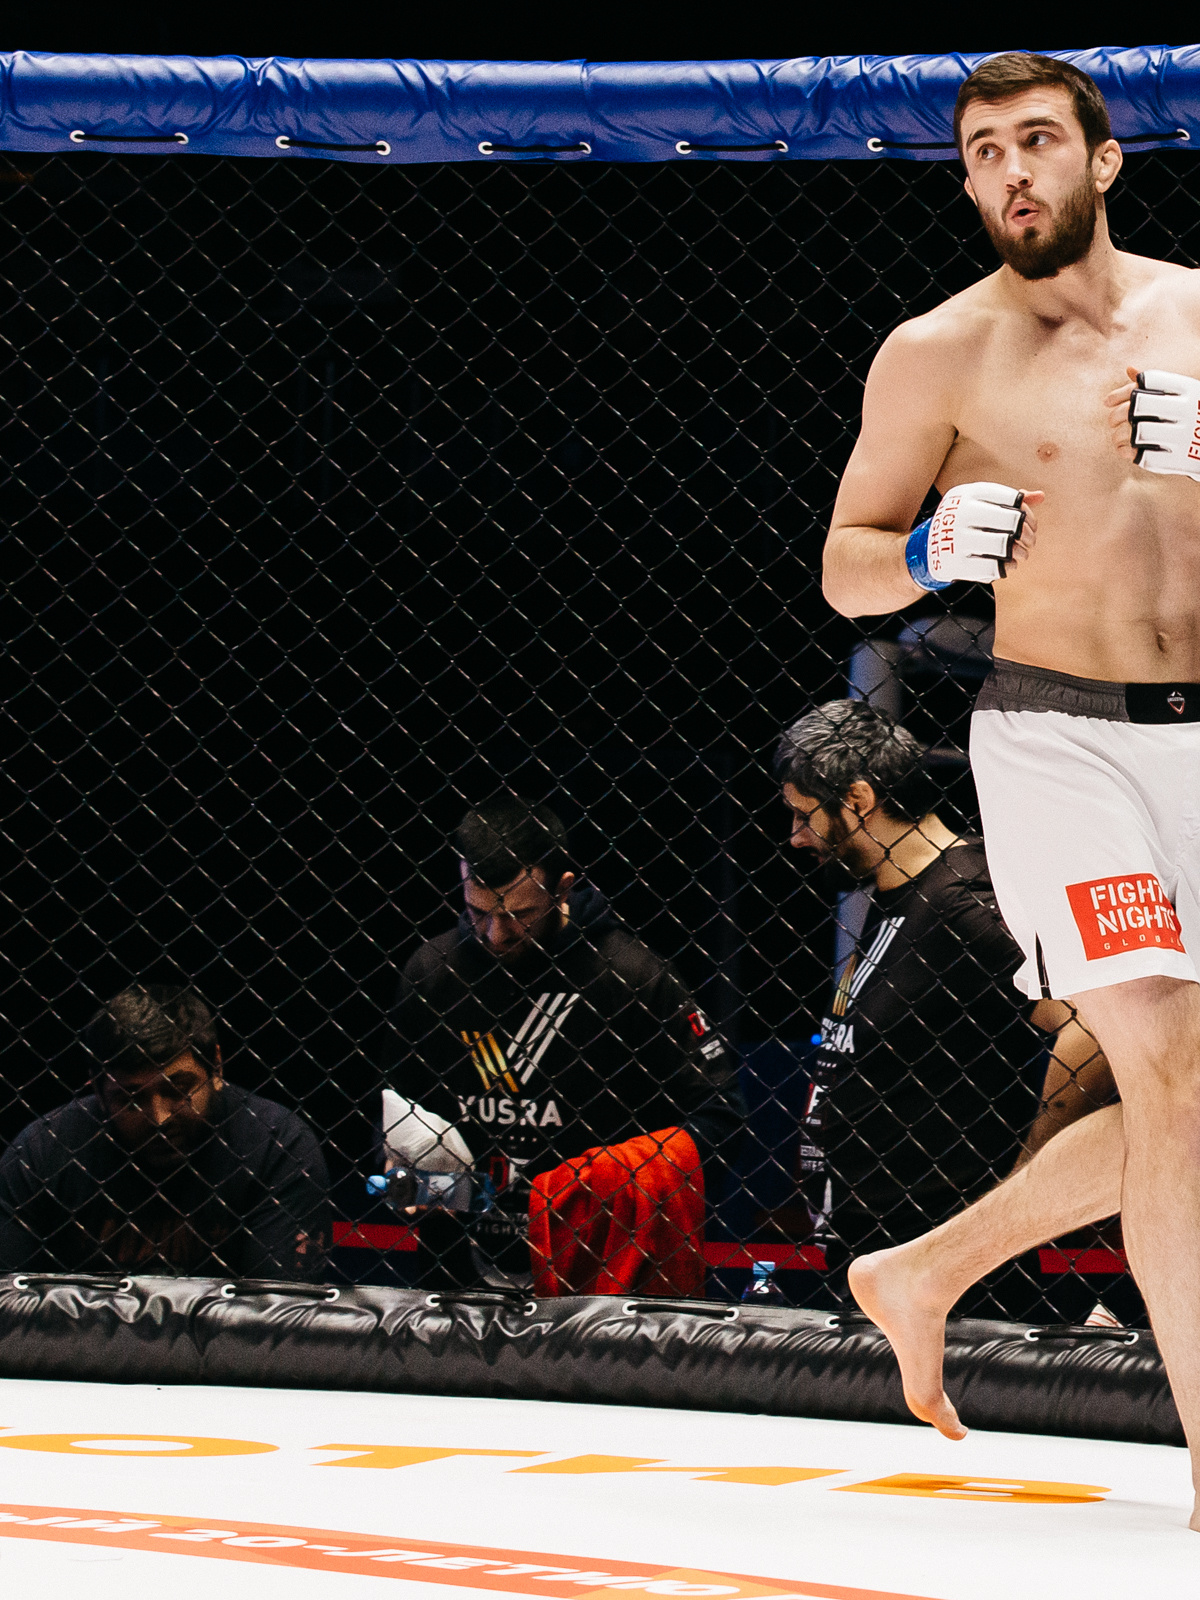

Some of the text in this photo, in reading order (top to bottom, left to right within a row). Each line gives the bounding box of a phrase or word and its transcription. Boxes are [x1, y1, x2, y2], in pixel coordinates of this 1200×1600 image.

[941, 495, 962, 554] FIGHT
[1089, 879, 1164, 910] FIGHT
[1096, 905, 1177, 936] NIGHTS
[457, 1095, 563, 1127] YUSRA
[0, 1426, 1112, 1504] ОТИВ
[148, 1528, 741, 1596] 20-ЛЕТИЮ
